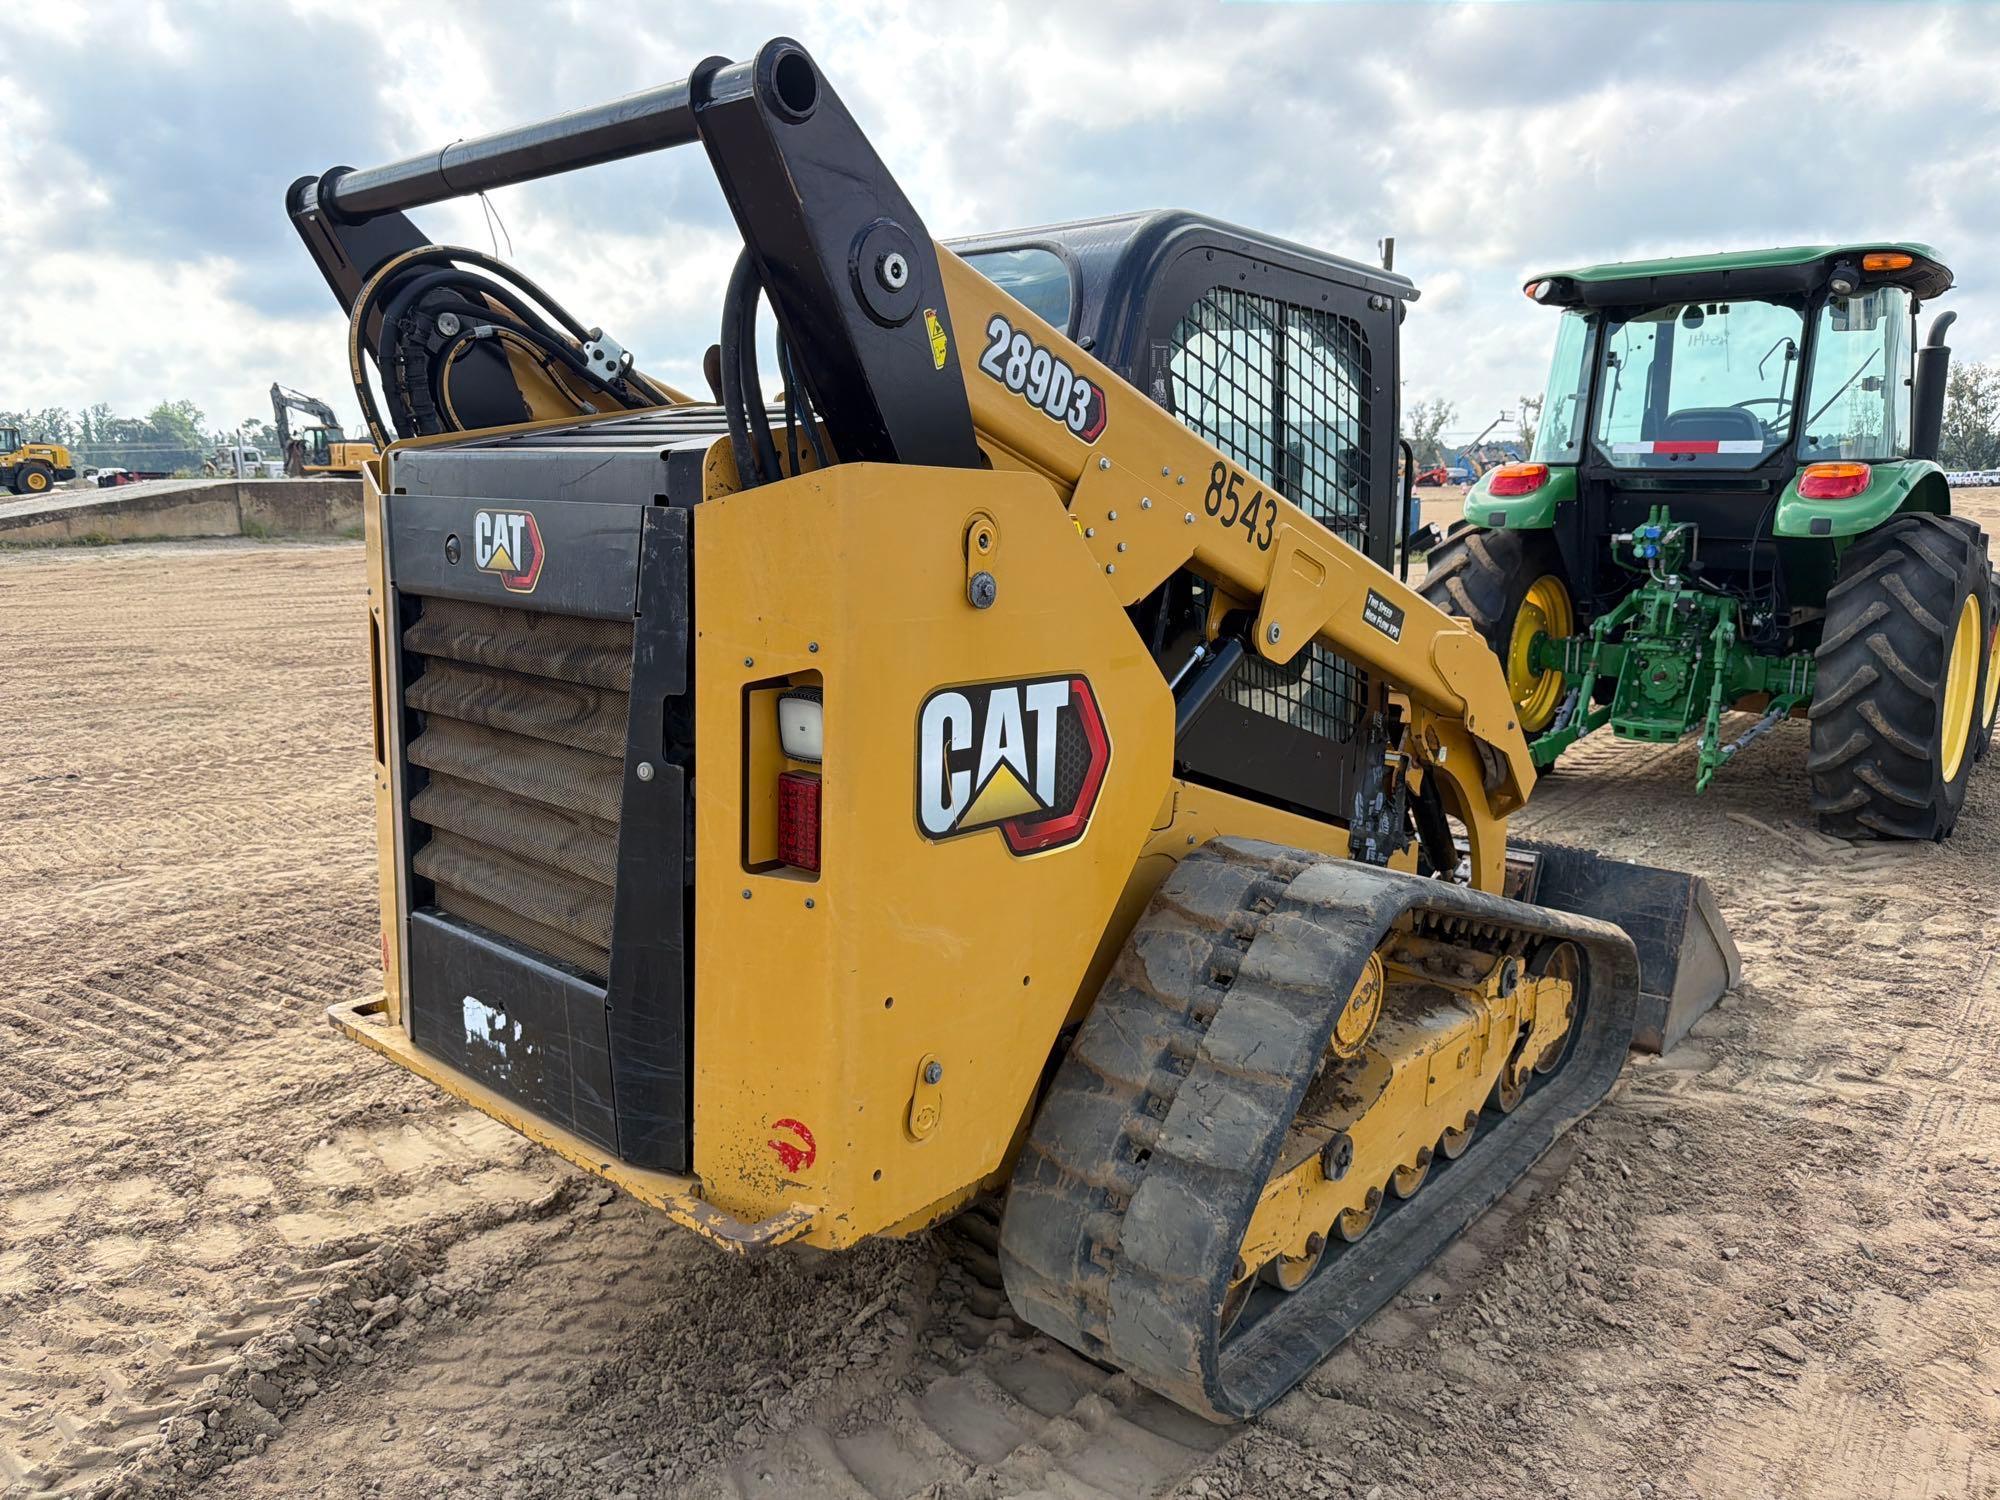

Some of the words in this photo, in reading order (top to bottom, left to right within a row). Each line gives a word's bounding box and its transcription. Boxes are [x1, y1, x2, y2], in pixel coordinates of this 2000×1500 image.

[980, 317, 1092, 431] 289D3
[475, 511, 525, 571] CAT
[1205, 461, 1277, 551] 8543
[921, 680, 1069, 833] CAT
